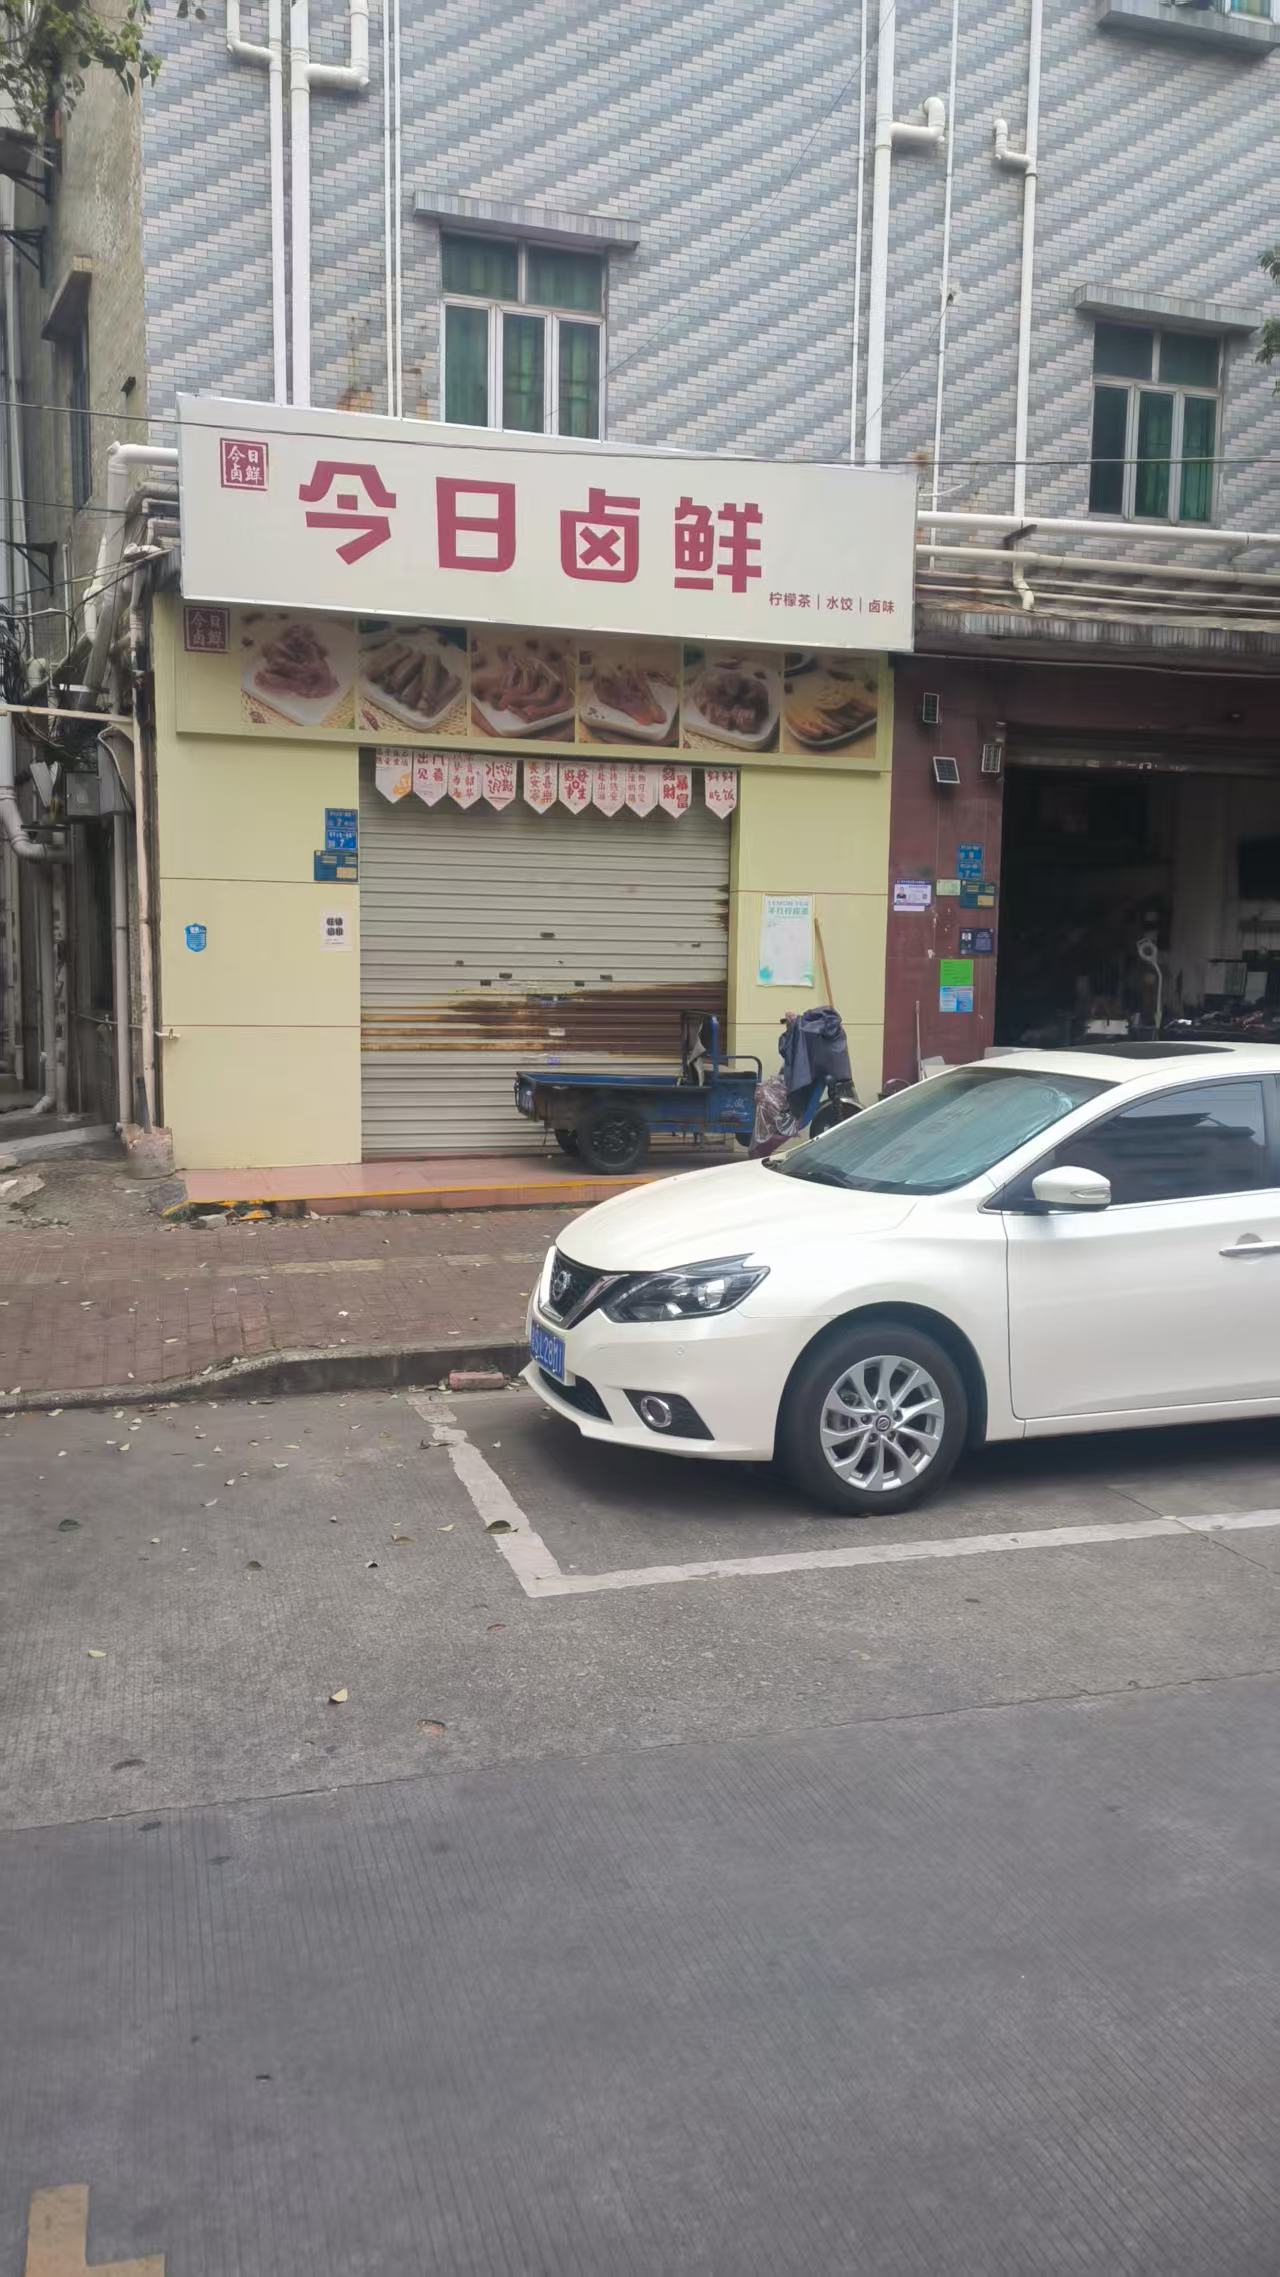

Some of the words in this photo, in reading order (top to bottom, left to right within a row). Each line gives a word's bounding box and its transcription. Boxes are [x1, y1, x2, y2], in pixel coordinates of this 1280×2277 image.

[298, 460, 763, 593] 今日卤鲜
[769, 592, 811, 608] 柠檬茶
[826, 596, 853, 611] 水饺
[868, 600, 895, 614] 卤味
[709, 789, 735, 801] 吃饭
